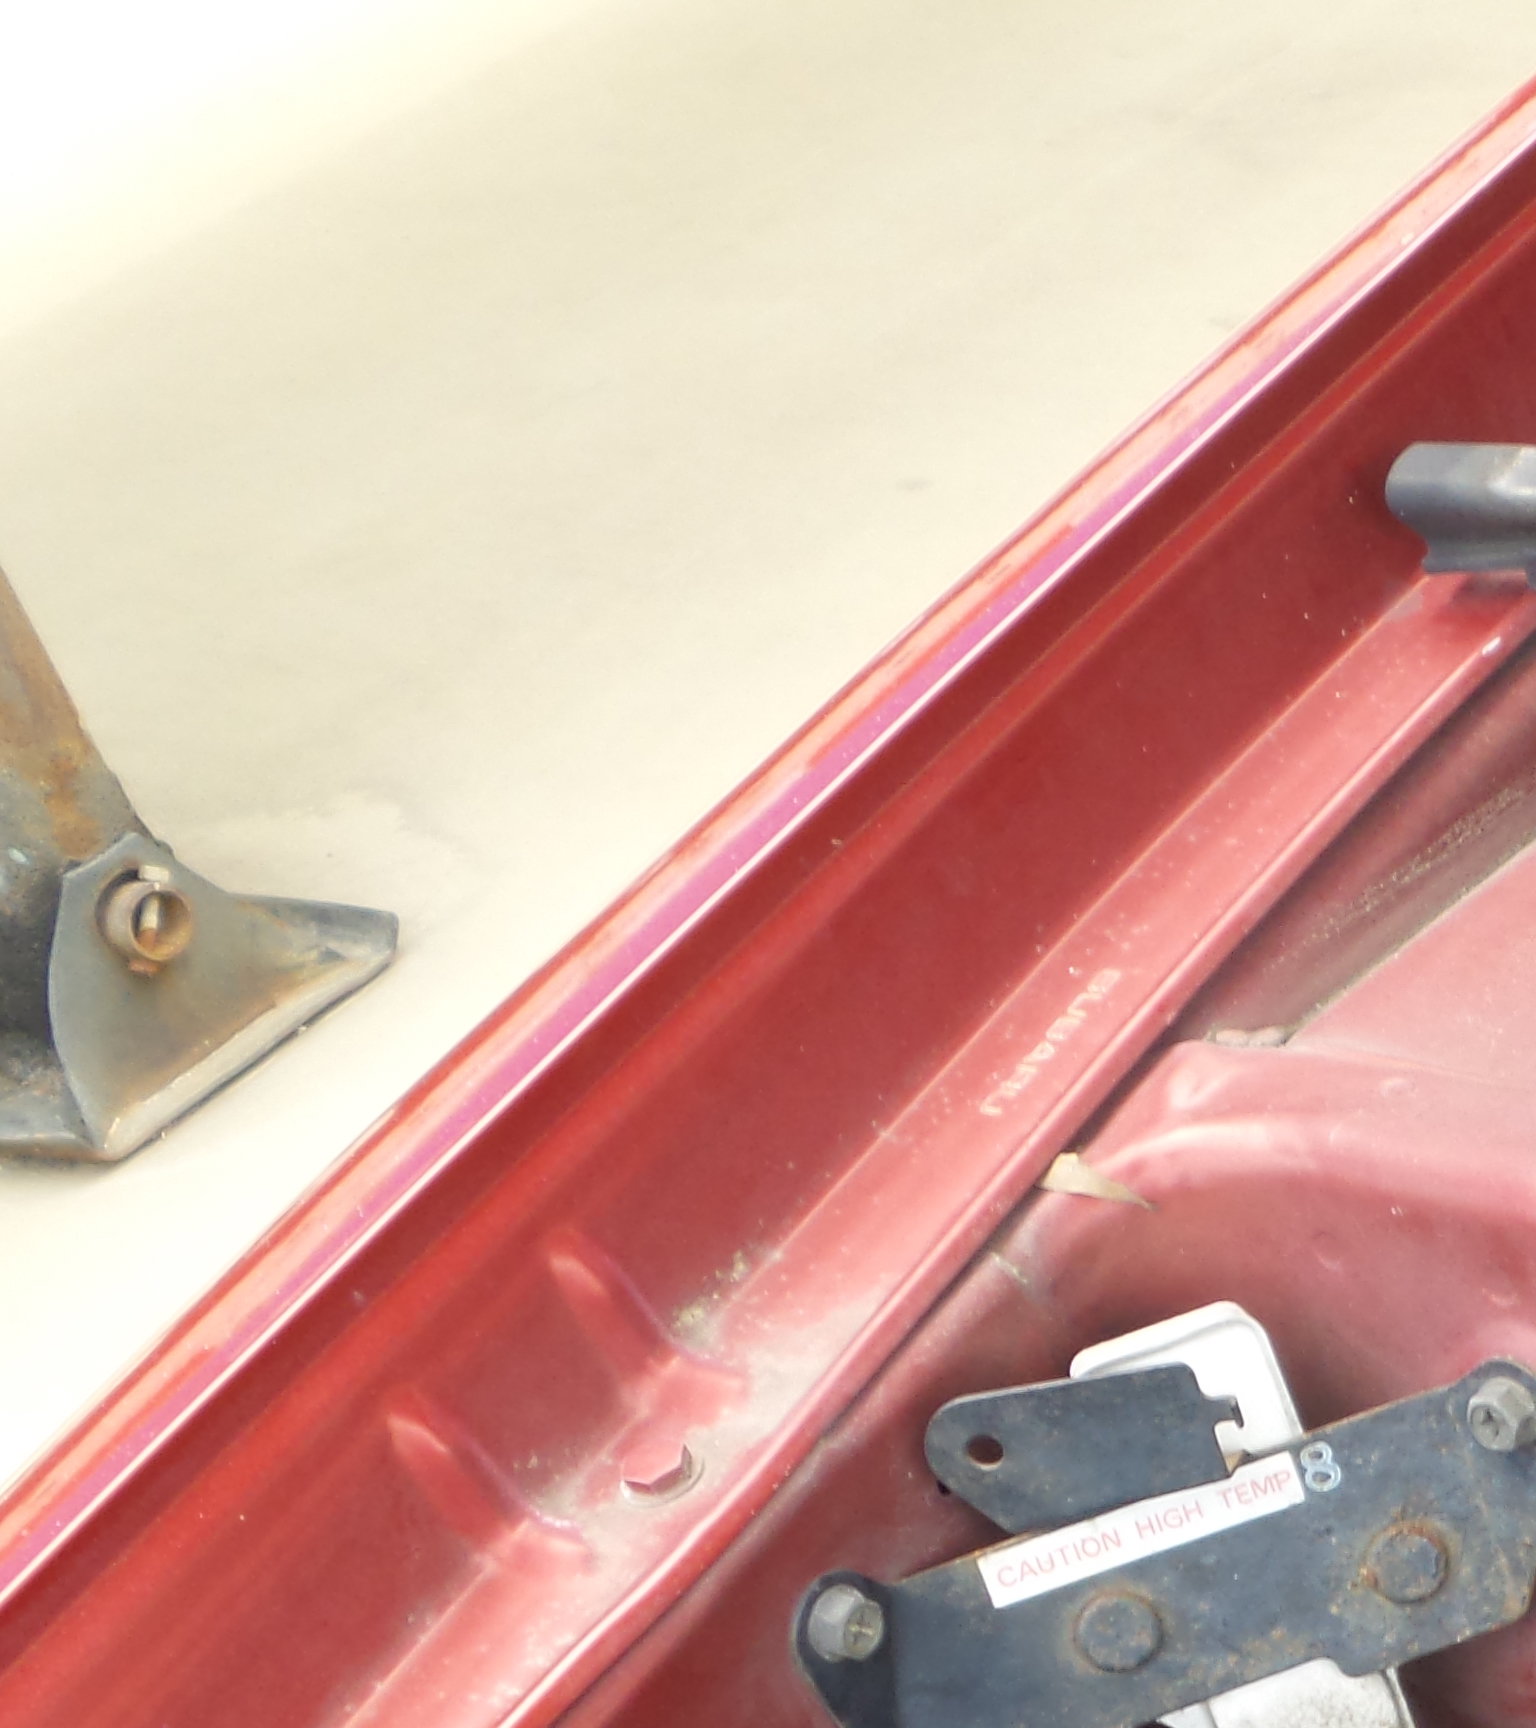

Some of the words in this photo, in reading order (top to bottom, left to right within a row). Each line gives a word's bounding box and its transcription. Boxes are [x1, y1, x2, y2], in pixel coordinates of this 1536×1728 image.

[980, 967, 1121, 1117] SUBARU
[996, 1528, 1122, 1589] CAUTION
[1134, 1503, 1205, 1541] HIGH
[1216, 1470, 1293, 1510] TEMP
